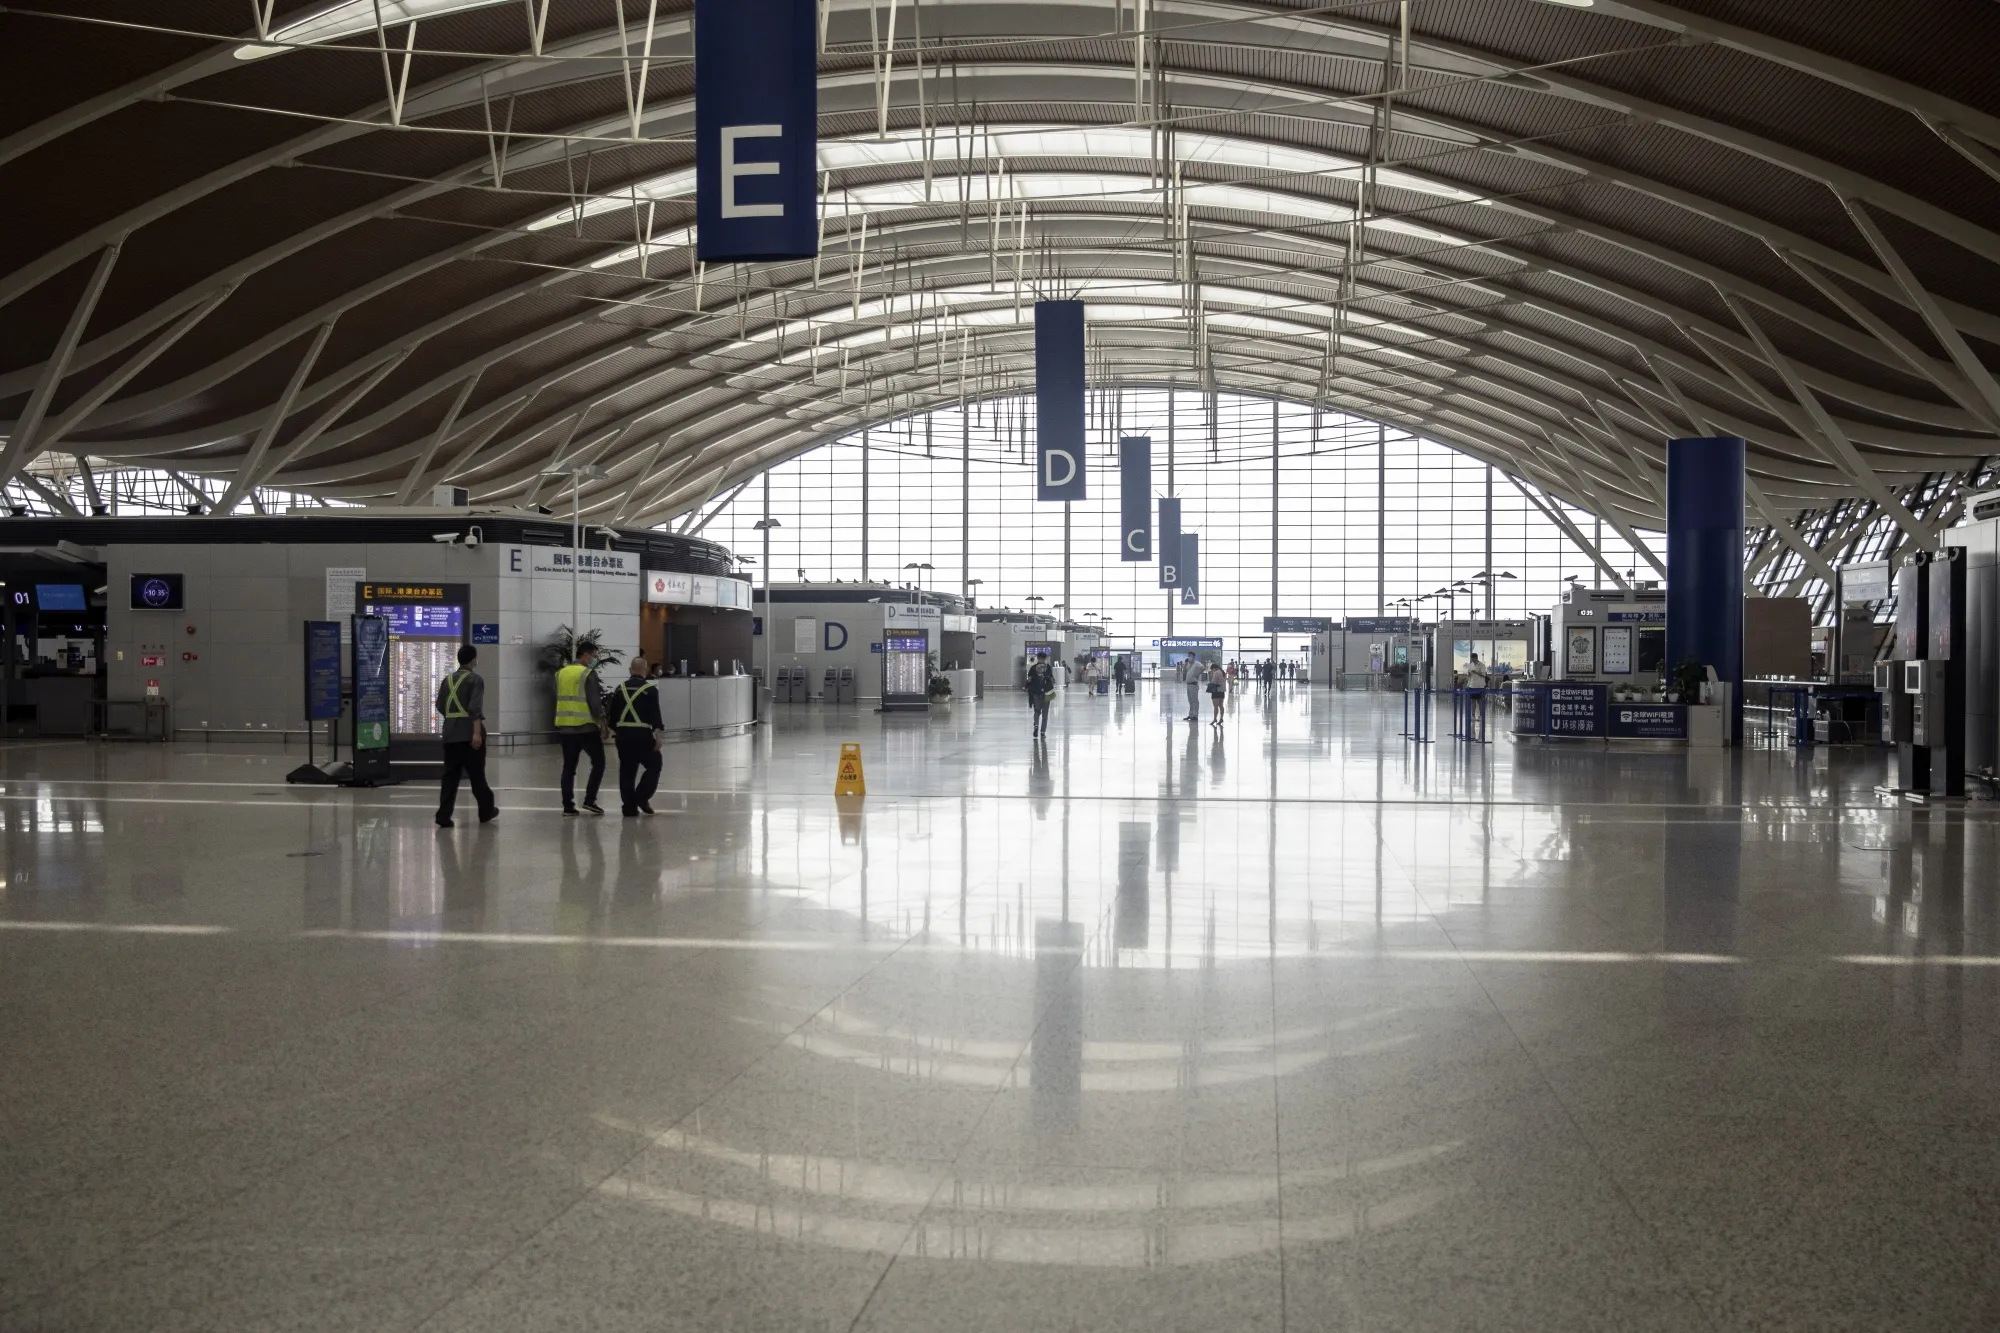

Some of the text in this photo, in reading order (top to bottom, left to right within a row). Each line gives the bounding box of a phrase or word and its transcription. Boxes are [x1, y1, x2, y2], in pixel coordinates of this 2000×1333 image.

[721, 125, 784, 219] E
[1045, 450, 1076, 486] D
[1127, 529, 1145, 552] C
[511, 549, 522, 572] E
[1163, 566, 1176, 582] B
[15, 592, 30, 604] 01
[364, 586, 372, 598] E
[1184, 587, 1196, 600] A
[889, 606, 896, 617] D
[1640, 613, 1646, 621] 2
[825, 622, 848, 651] D
[972, 636, 986, 654] C
[1562, 719, 1594, 731] 环球漫游
